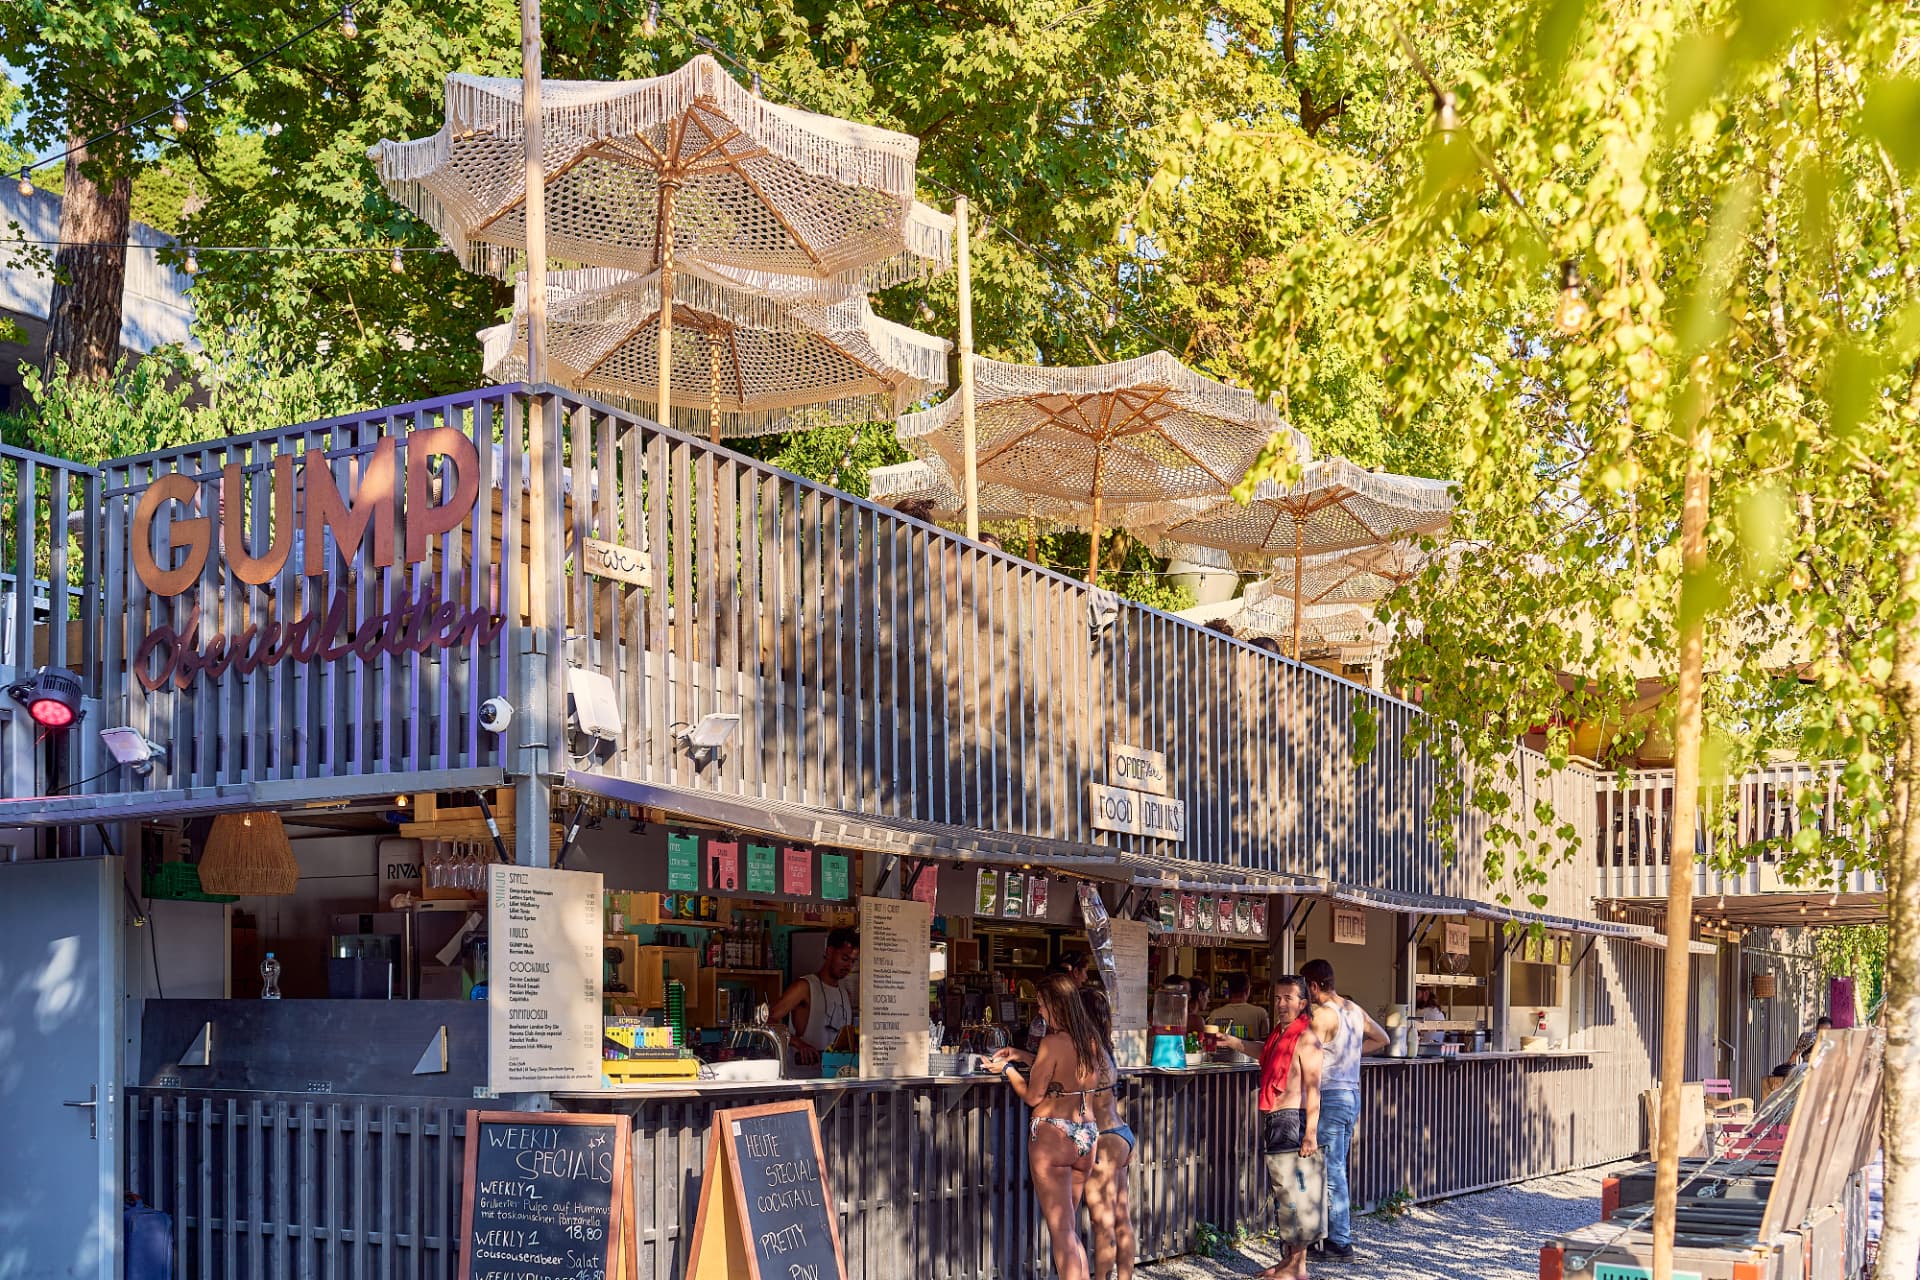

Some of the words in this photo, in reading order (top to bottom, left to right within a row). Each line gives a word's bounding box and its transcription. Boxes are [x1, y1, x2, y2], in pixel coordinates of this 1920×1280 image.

[132, 427, 480, 596] GUMP
[1100, 795, 1133, 824] FOOD
[1145, 801, 1180, 833] DRINKS
[509, 961, 550, 973] COCKTAILS
[488, 1128, 561, 1149] WEEKLY
[745, 1133, 781, 1158] HEUTE
[516, 1149, 612, 1183] SPECIALS
[765, 1159, 817, 1187] SPECIAL
[480, 1181, 526, 1197] WEEKLY
[526, 1184, 543, 1199] 2
[757, 1188, 820, 1213] COCKTAIL
[523, 1200, 548, 1214] Pulpo
[553, 1202, 571, 1214] auf
[574, 1202, 612, 1215] Hummus
[475, 1230, 525, 1248] WEEKLY
[528, 1230, 540, 1246] 1
[565, 1225, 602, 1242] 18,80
[760, 1223, 807, 1260] PRETTY
[567, 1249, 599, 1269] Salat
